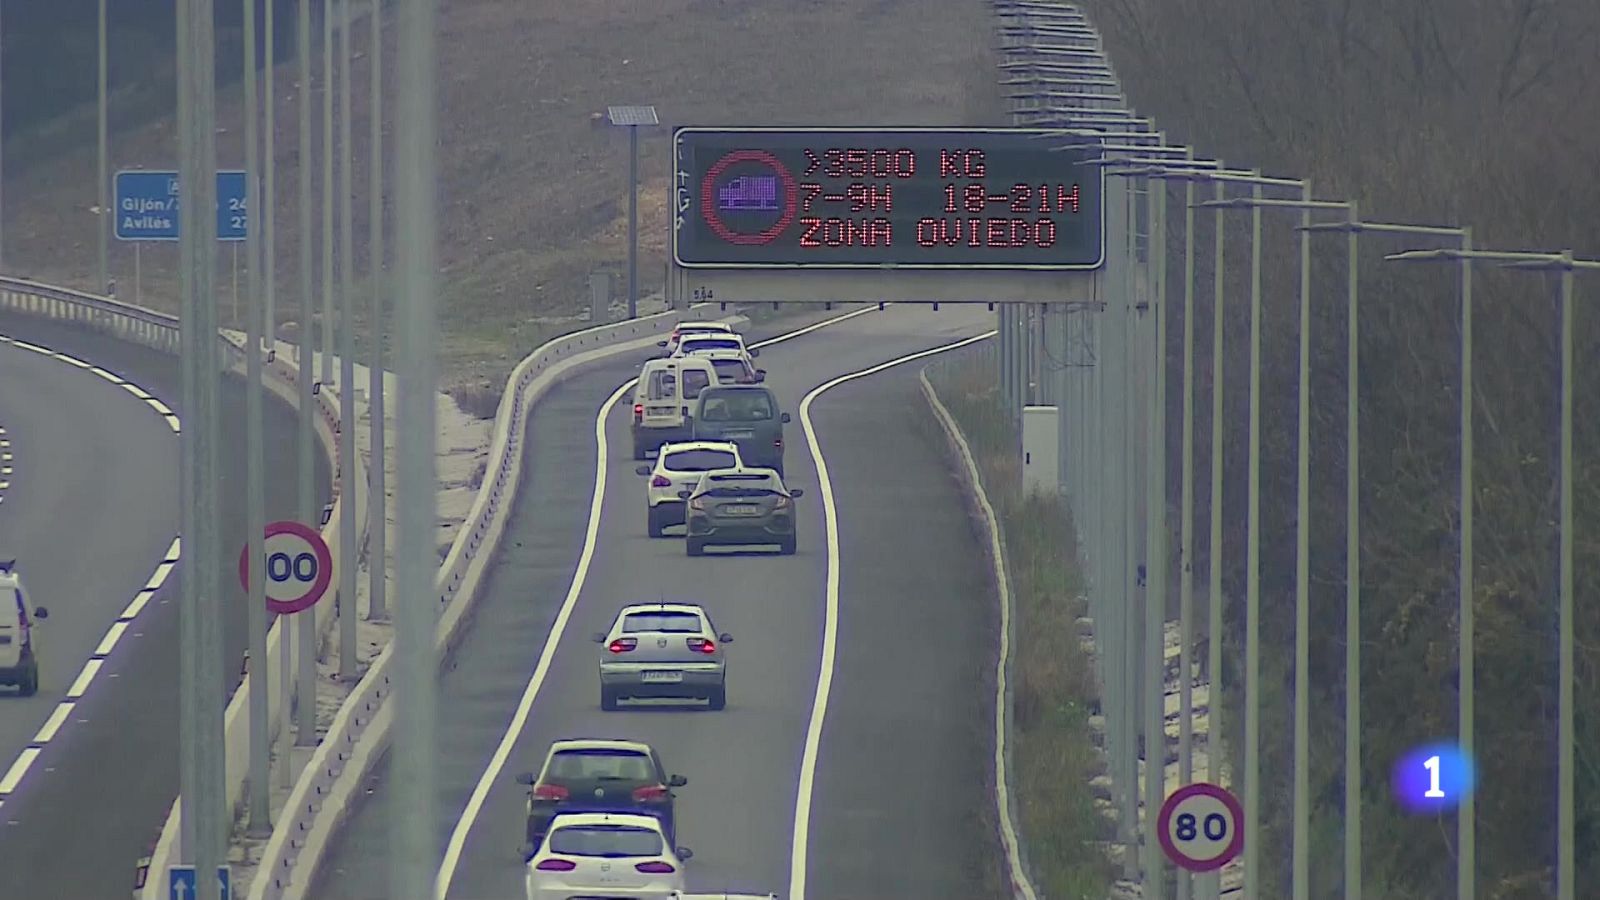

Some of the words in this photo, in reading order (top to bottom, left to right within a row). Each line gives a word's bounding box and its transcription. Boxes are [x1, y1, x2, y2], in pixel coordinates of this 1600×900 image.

[803, 149, 917, 179] >3500
[939, 149, 987, 179] KG
[798, 183, 893, 213] 7-9H
[943, 183, 1081, 213] 18-21H
[798, 217, 893, 249] ZONA
[916, 217, 1057, 249] OVIEDO
[264, 552, 318, 582] 00
[1176, 812, 1227, 842] 80
